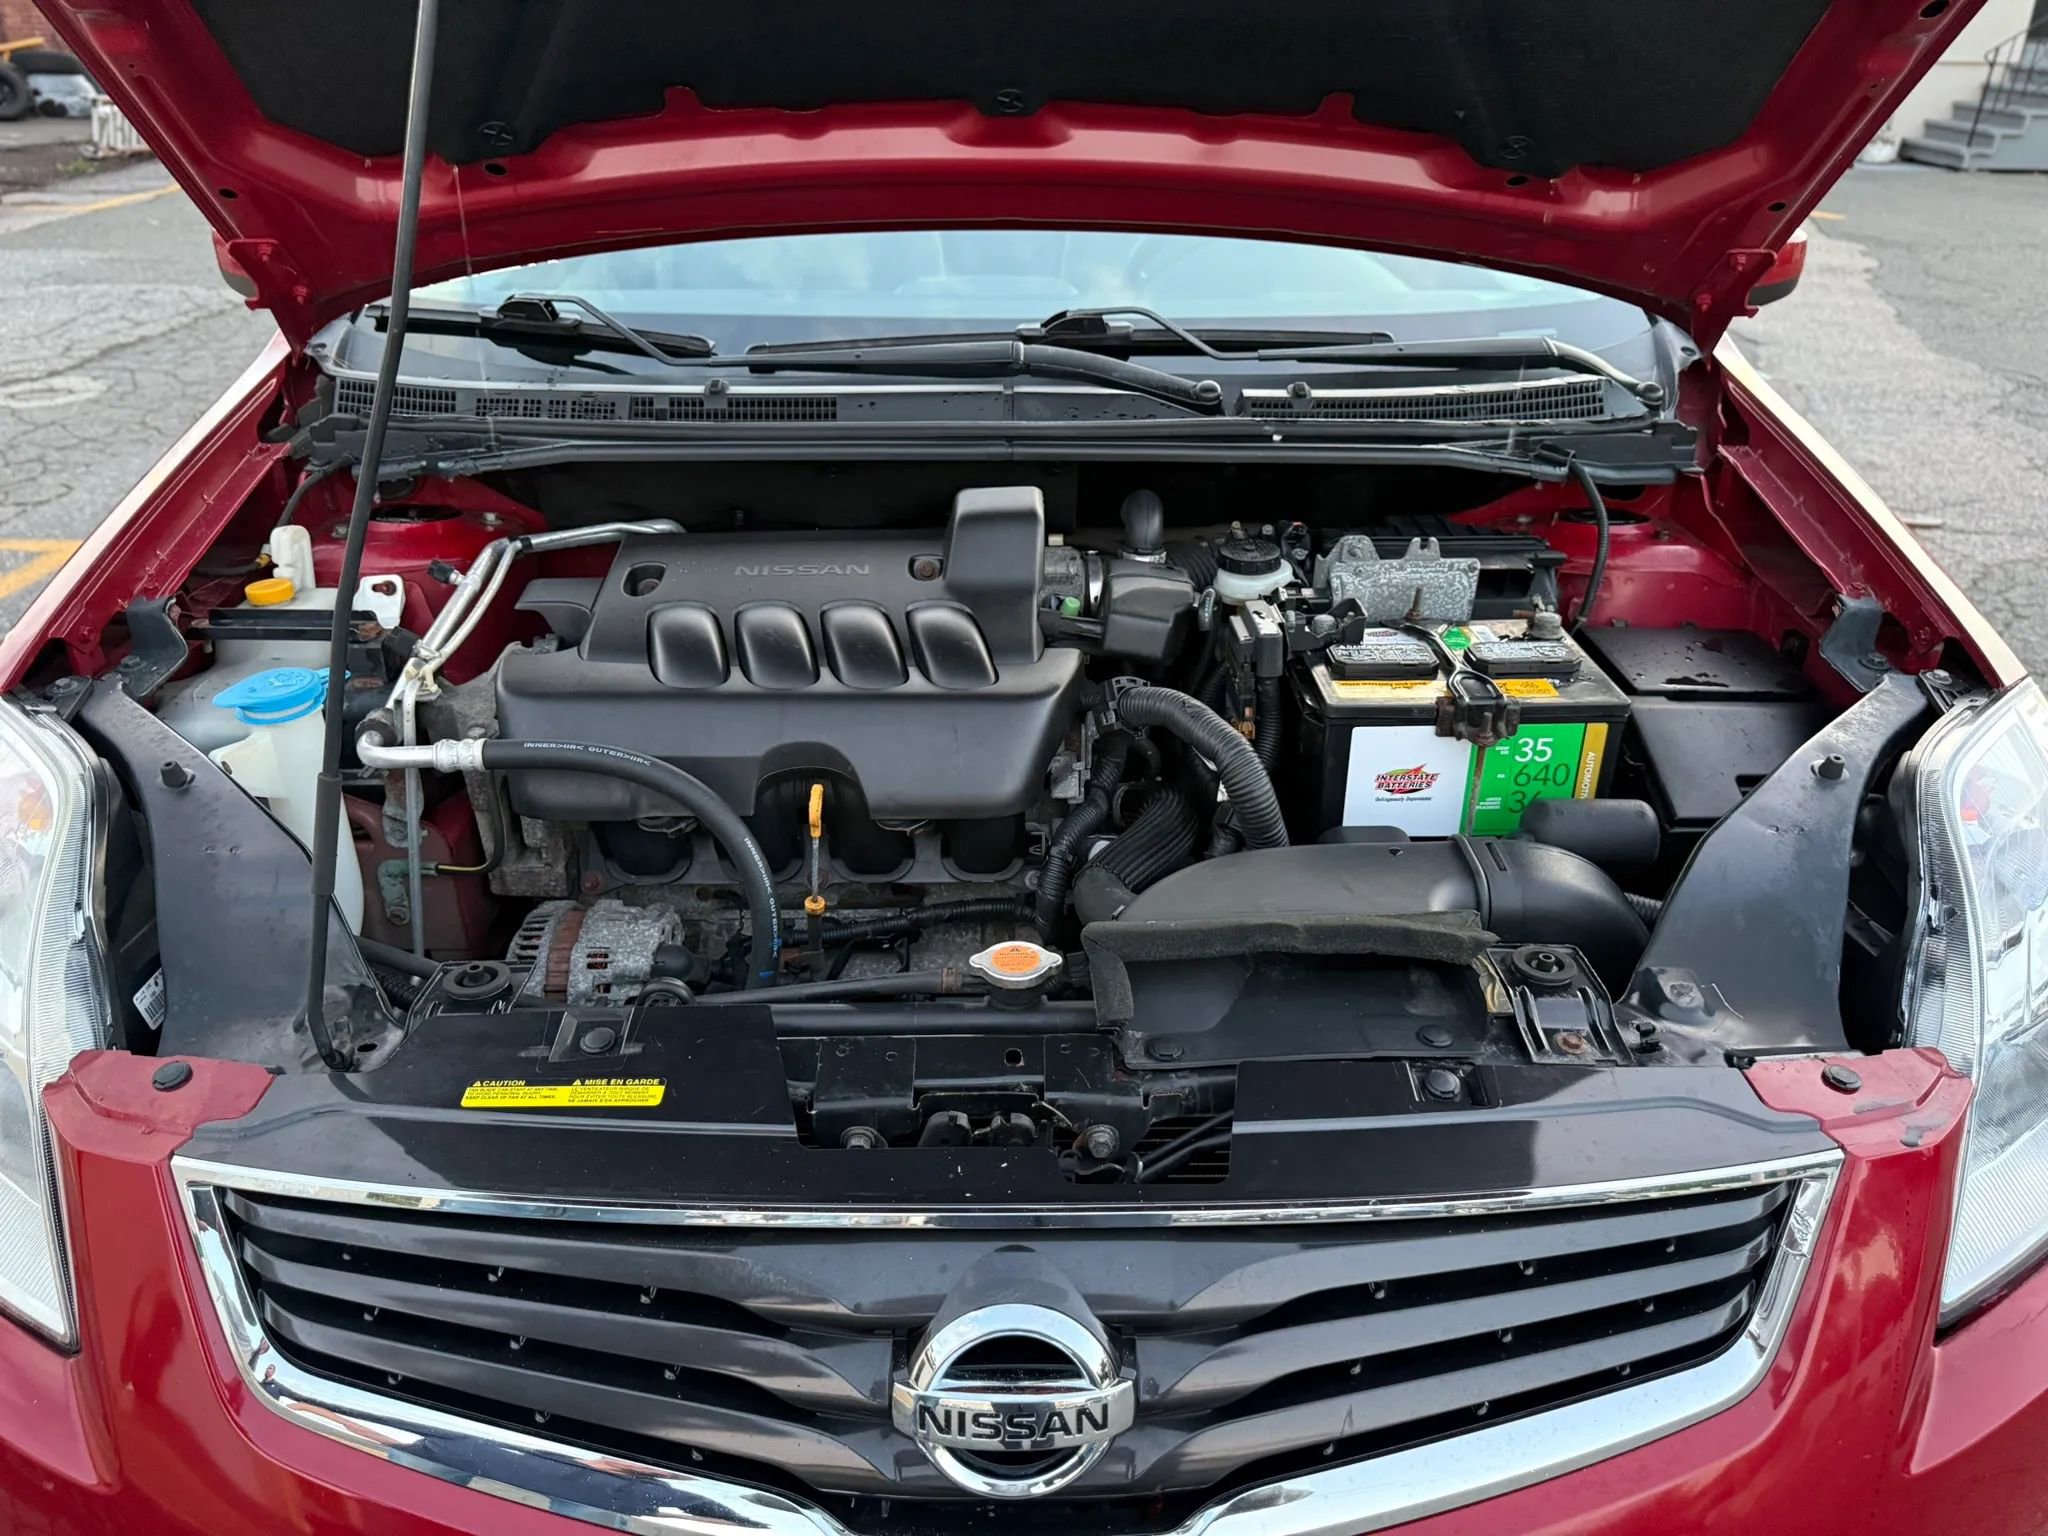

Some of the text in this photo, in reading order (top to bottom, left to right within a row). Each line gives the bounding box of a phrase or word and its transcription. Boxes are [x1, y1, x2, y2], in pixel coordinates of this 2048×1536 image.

[734, 564, 870, 576] NISSAN
[1514, 737, 1554, 762] 35
[1375, 773, 1440, 782] INTERSTATE
[1513, 763, 1571, 788] 640
[1375, 781, 1434, 790] BATTERIES
[917, 1402, 1110, 1440] NISSAN
